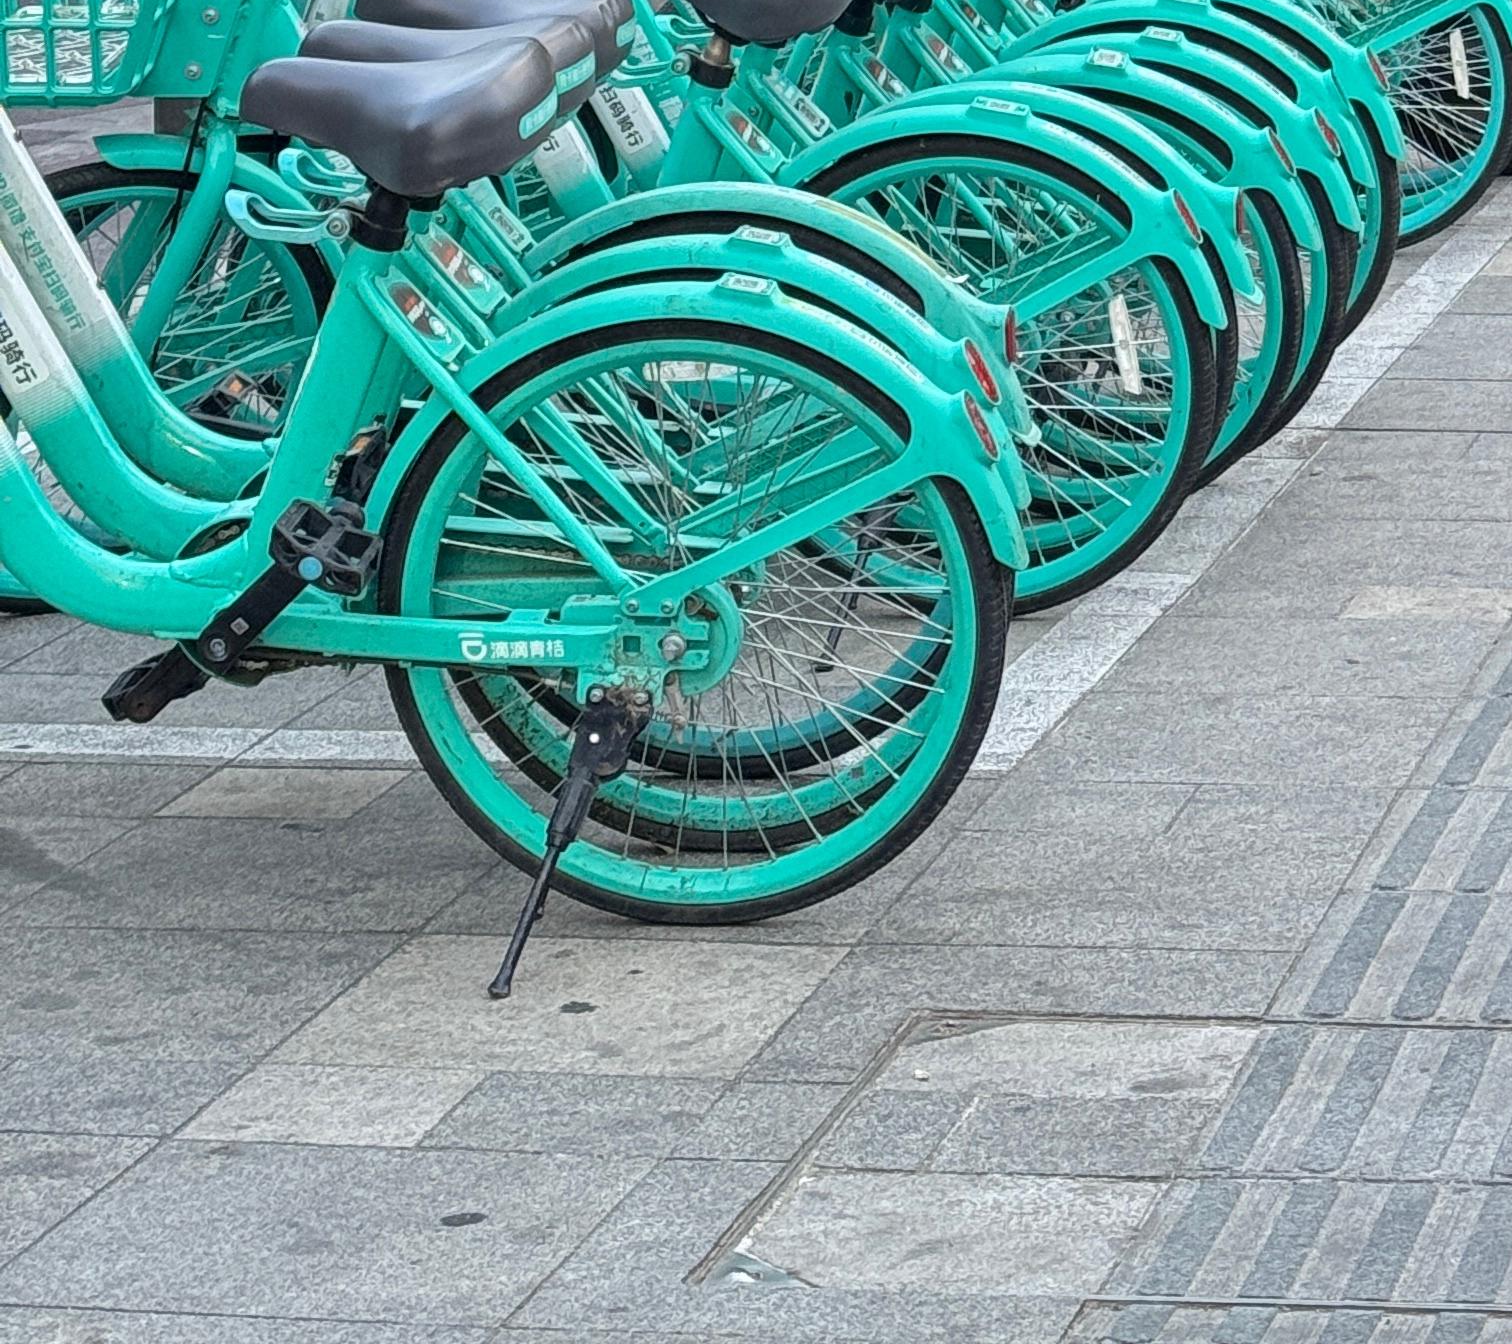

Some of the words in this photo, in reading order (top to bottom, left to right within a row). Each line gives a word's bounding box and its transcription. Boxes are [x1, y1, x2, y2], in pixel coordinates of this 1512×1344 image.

[599, 85, 644, 147] 扫码骑行
[490, 639, 565, 659] 滴滴青桔
